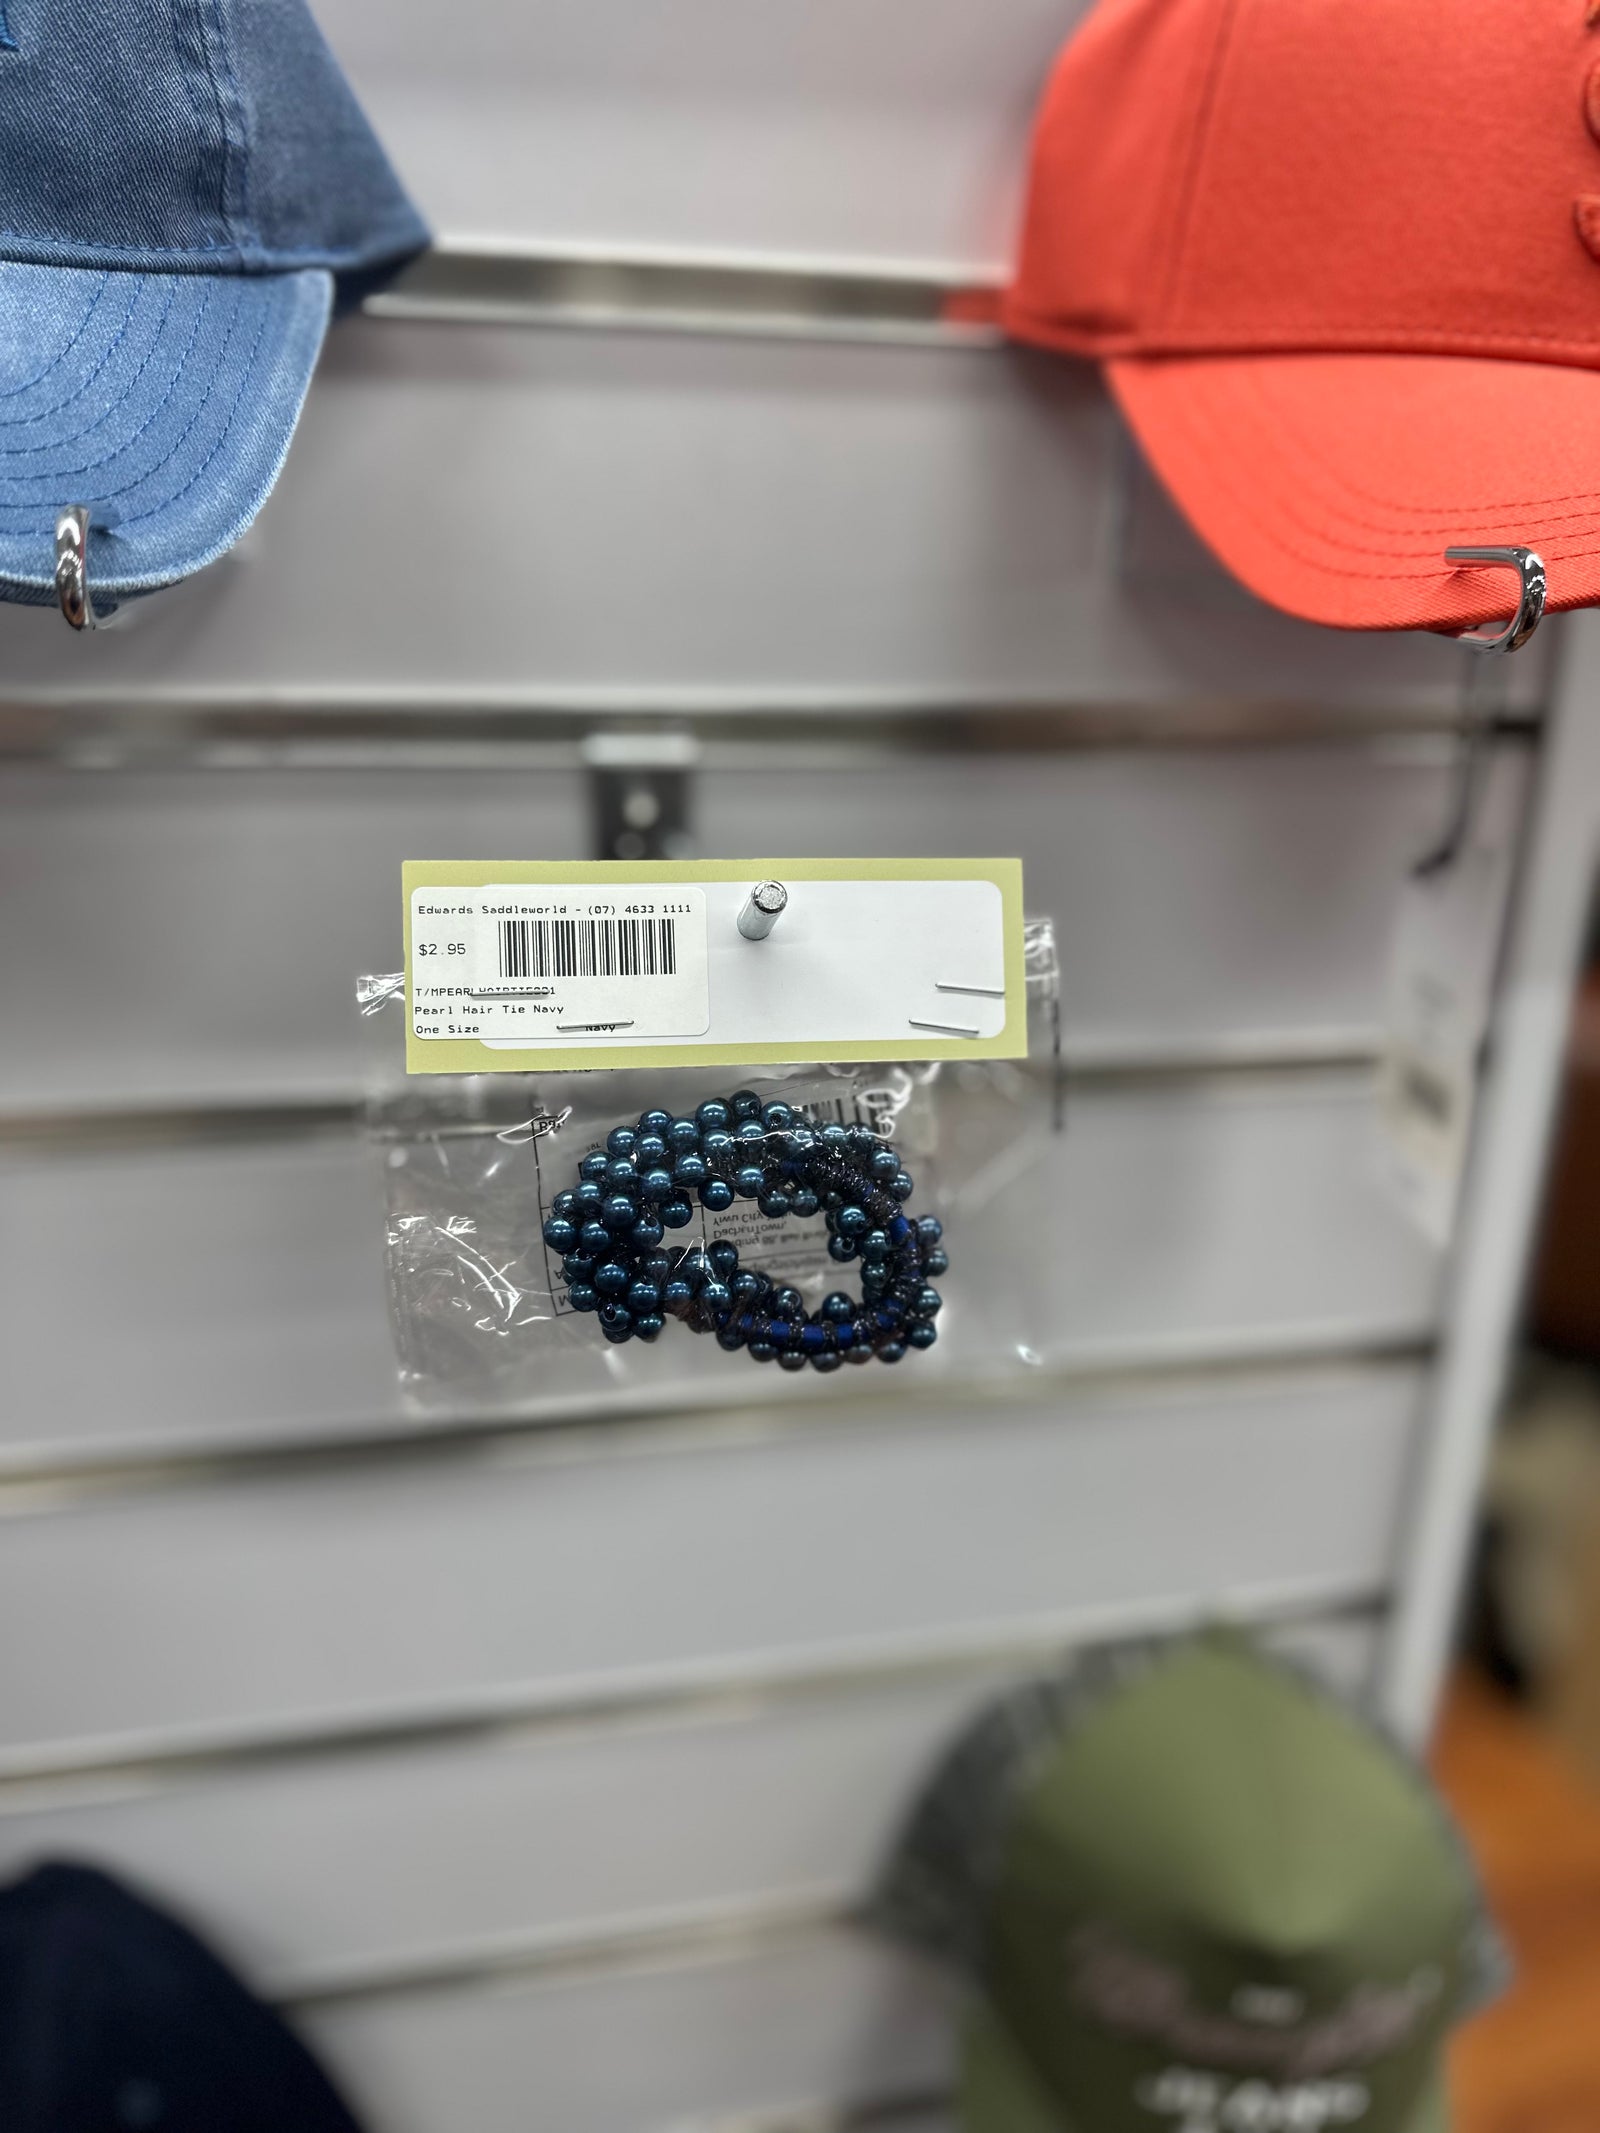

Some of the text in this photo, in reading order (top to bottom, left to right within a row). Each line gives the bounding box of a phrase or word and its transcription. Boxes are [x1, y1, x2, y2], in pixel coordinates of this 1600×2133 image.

[418, 905, 473, 915] Edwards
[482, 905, 567, 914] Saddleworld
[588, 904, 616, 916] (07)
[624, 904, 655, 914] 4633
[663, 904, 692, 913] 1111
[418, 943, 466, 957] $2.95
[415, 1004, 564, 1015] Pearl Hair Tie Navy
[415, 1025, 440, 1035] One
[447, 1024, 480, 1034] Size
